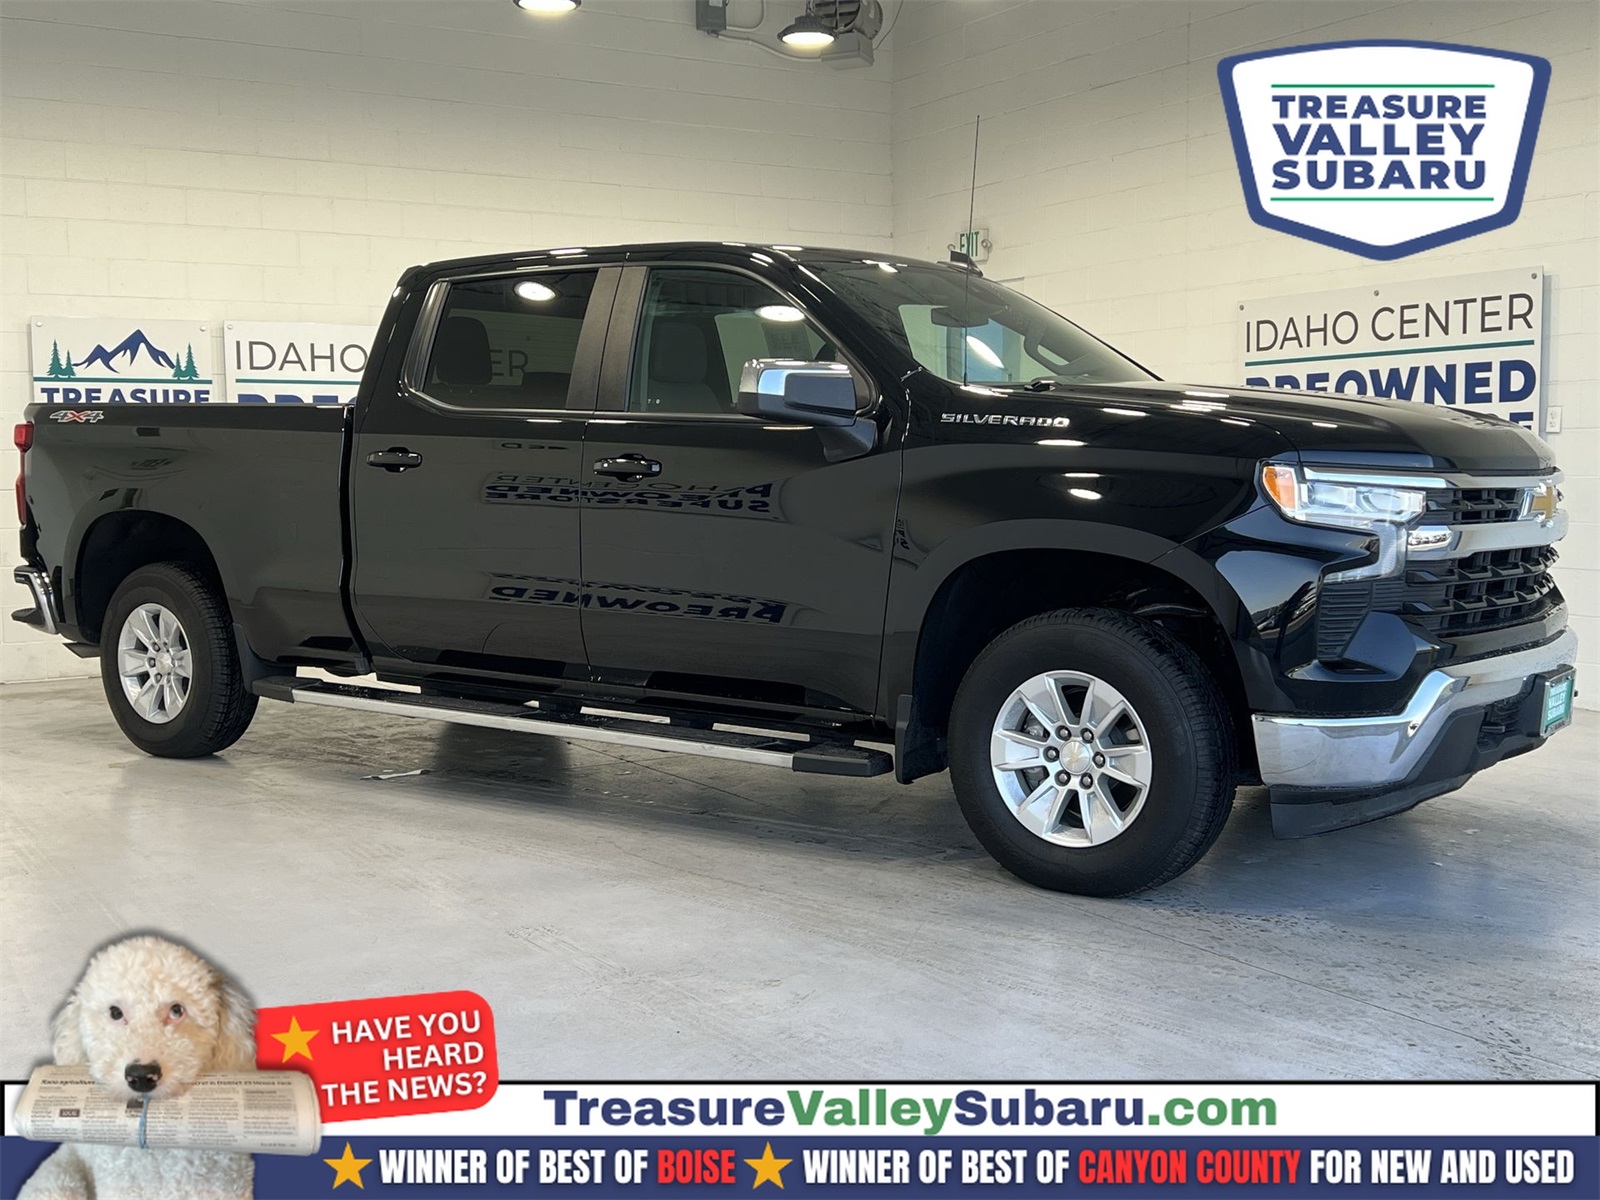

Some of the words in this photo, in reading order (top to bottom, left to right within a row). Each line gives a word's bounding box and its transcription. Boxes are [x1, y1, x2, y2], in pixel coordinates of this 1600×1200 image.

[960, 231, 979, 257] EXIT
[1246, 310, 1359, 353] IDAHO
[1371, 293, 1534, 342] CENTER
[236, 341, 368, 373] IDAHO
[41, 387, 210, 404] TREASURE
[1246, 359, 1536, 405] OWNED
[940, 413, 1071, 428] SILVERADO
